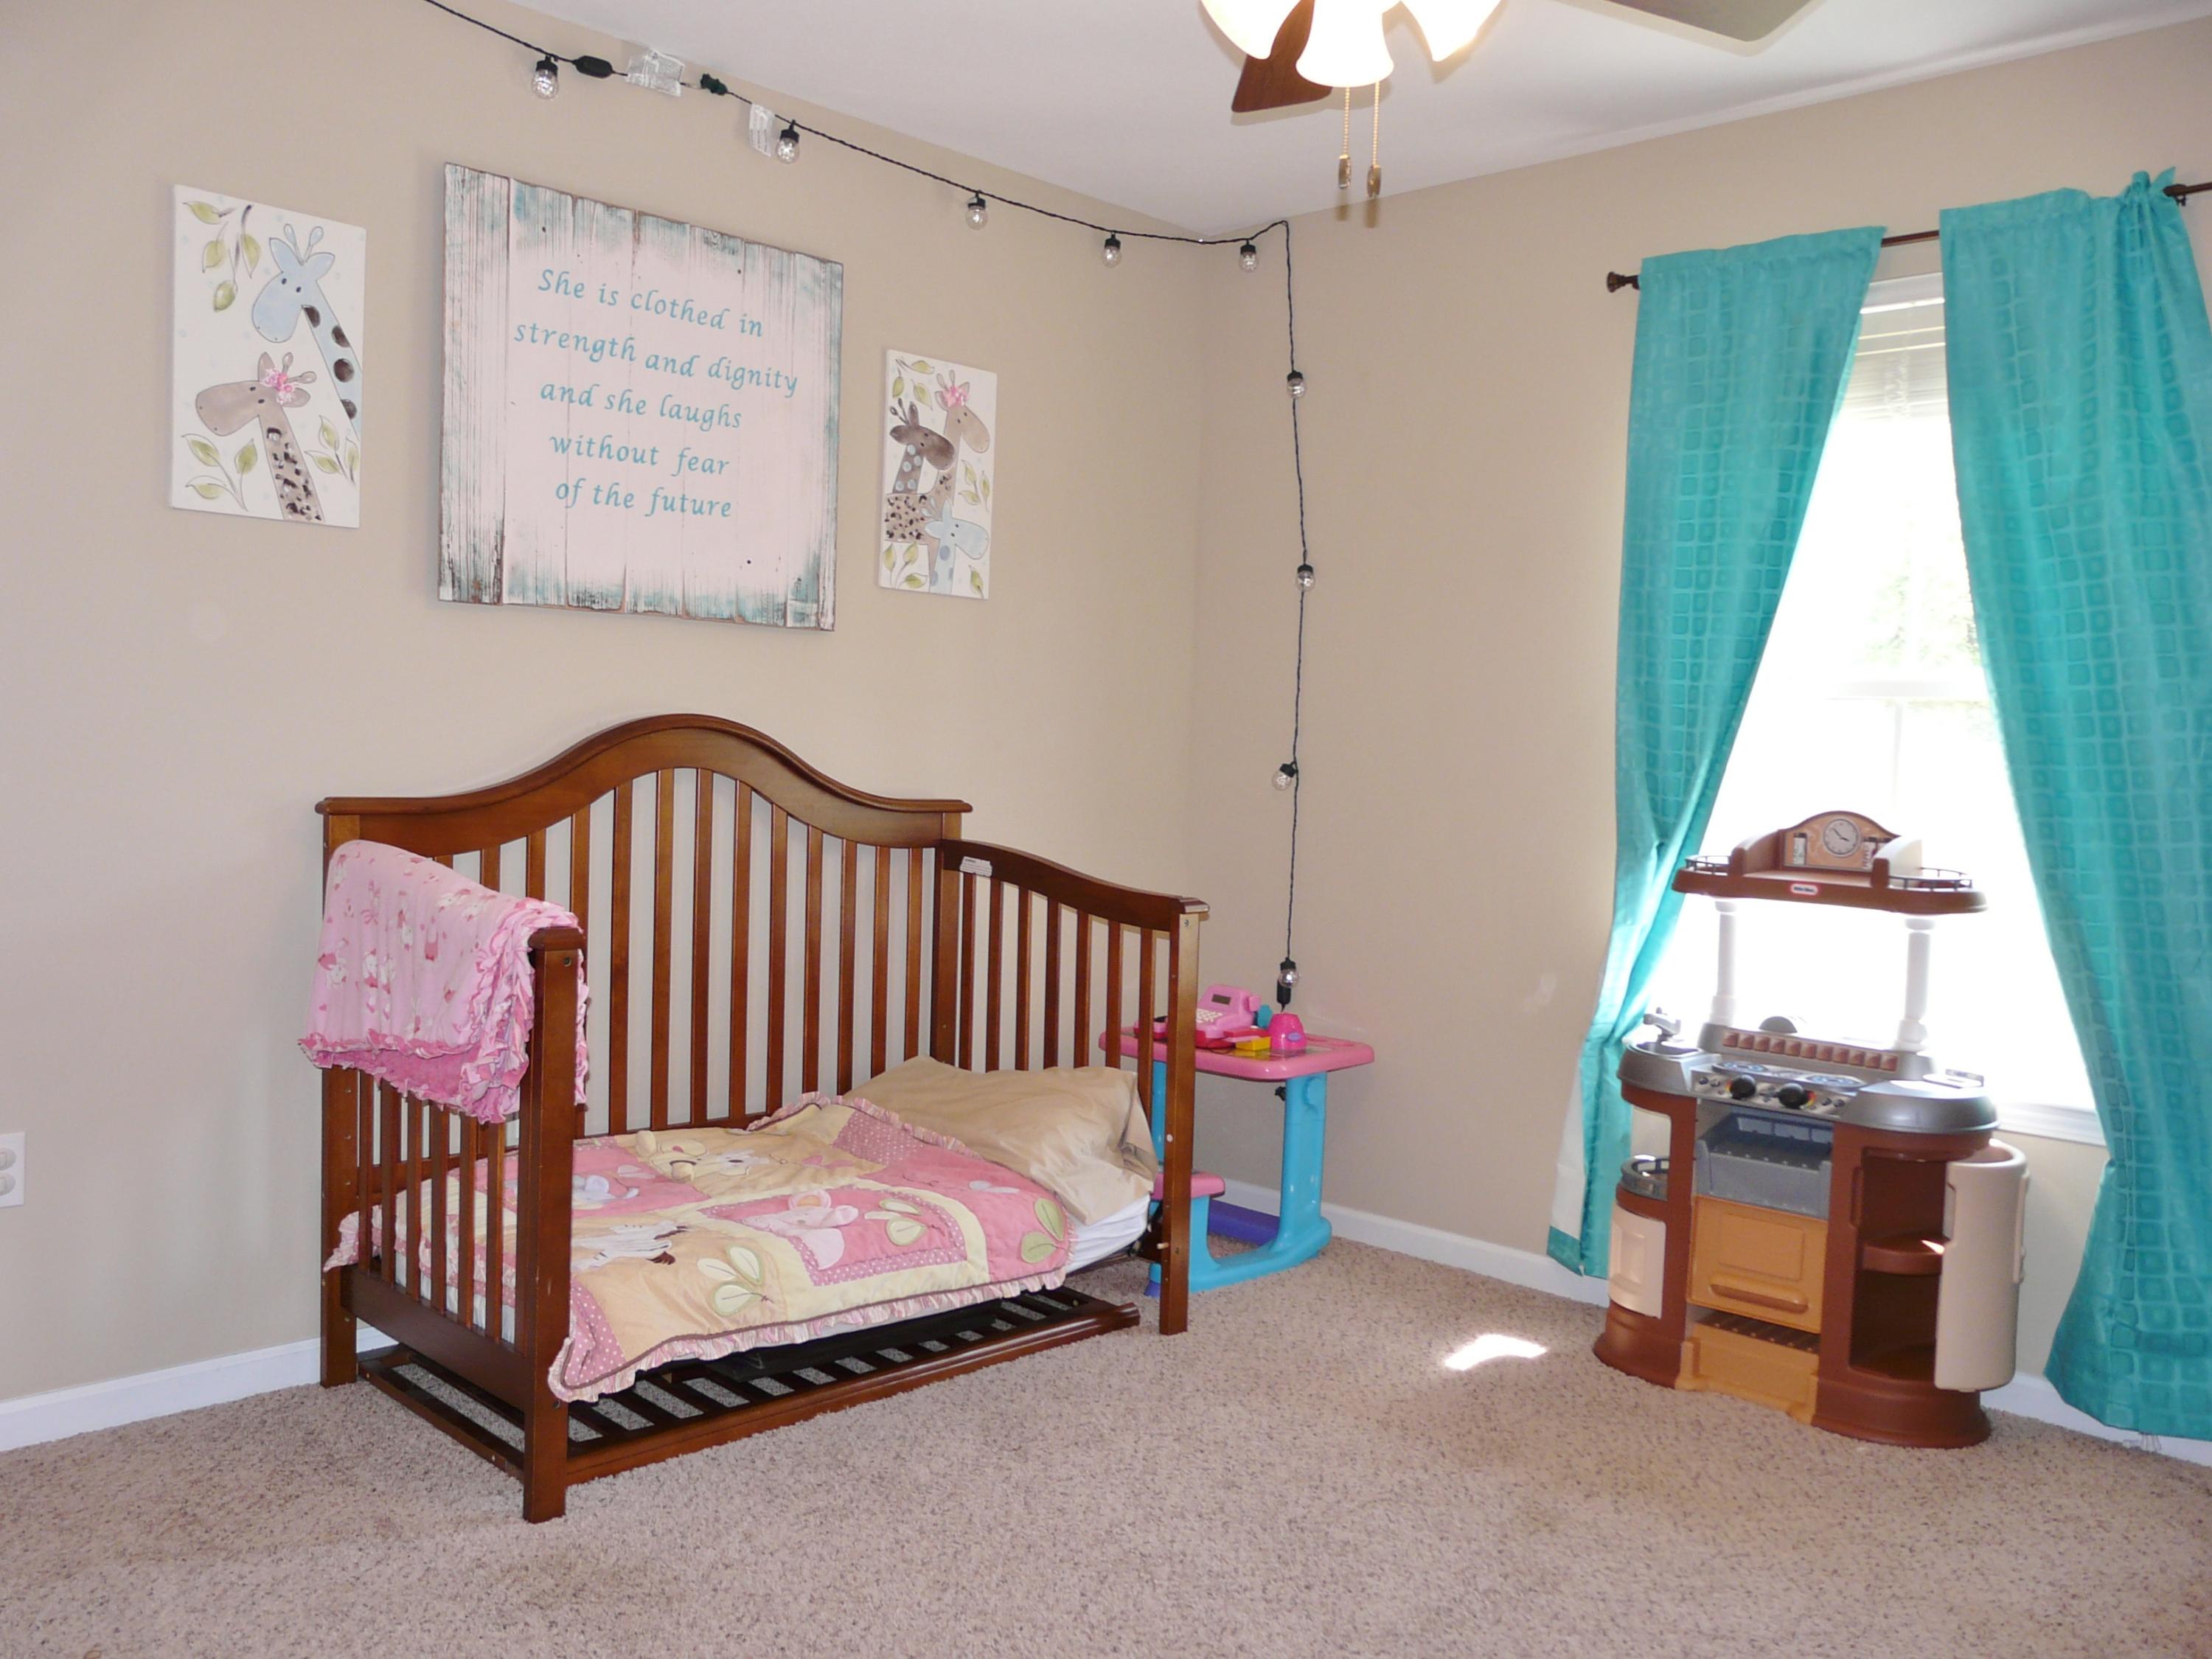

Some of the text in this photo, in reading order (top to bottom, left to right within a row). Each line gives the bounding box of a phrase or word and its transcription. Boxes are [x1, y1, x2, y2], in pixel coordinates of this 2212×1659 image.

[538, 268, 763, 338] She is clothed in
[514, 321, 798, 398] strength and dignity
[540, 383, 742, 432] and she laughs
[549, 434, 730, 476] without fear
[555, 478, 731, 518] of the future
